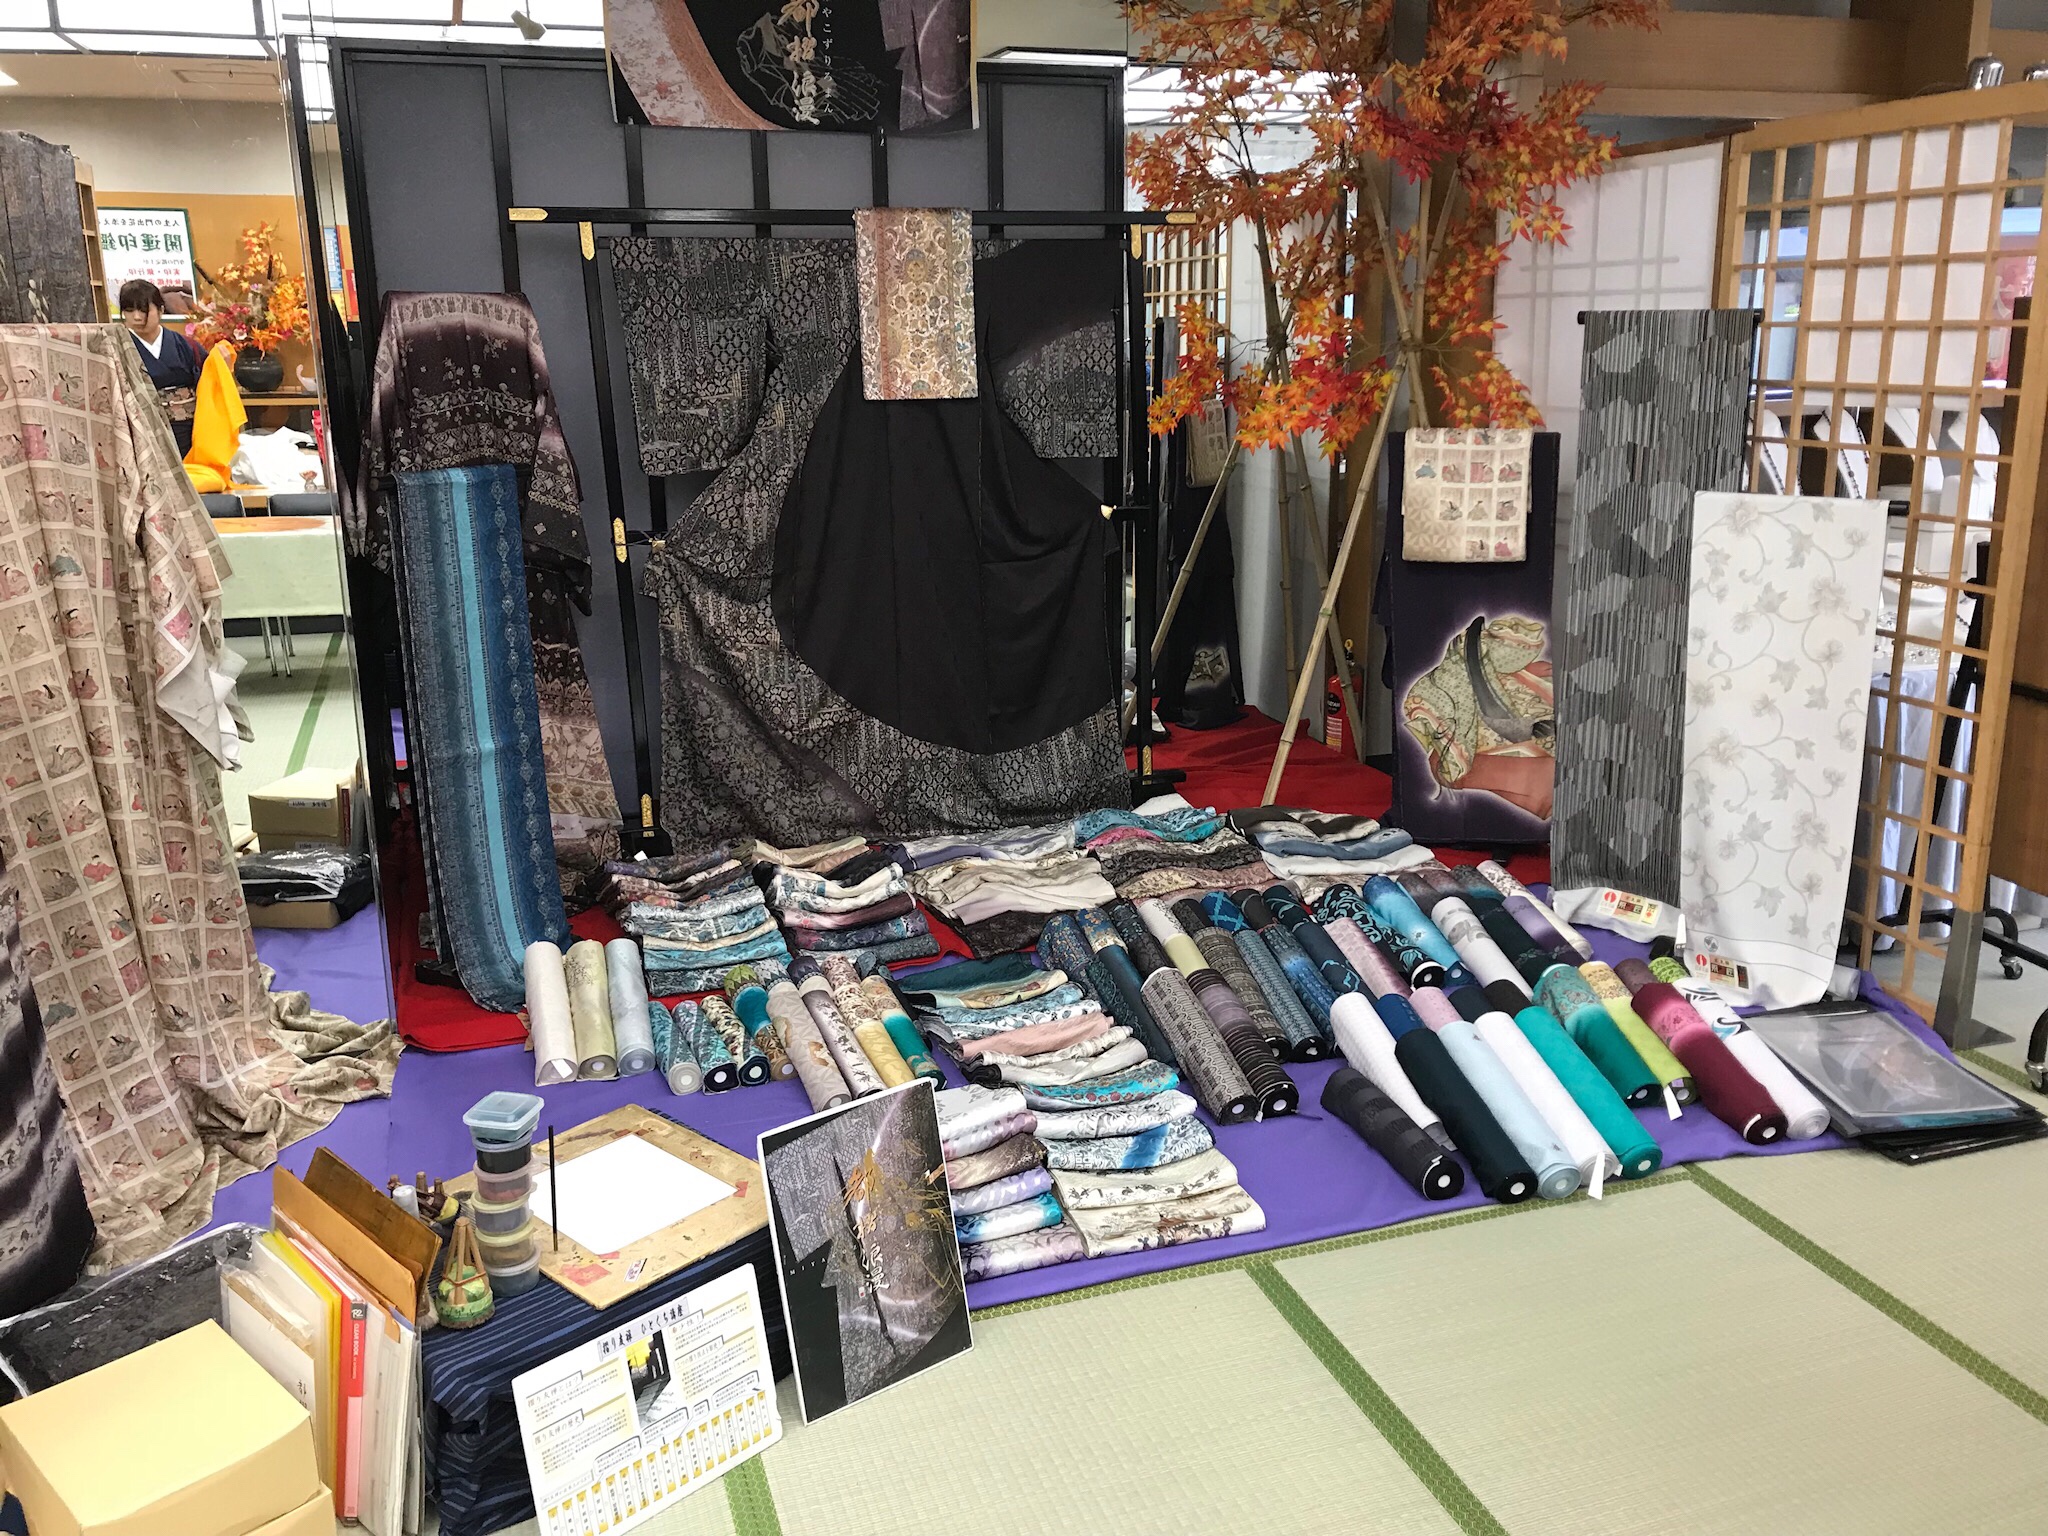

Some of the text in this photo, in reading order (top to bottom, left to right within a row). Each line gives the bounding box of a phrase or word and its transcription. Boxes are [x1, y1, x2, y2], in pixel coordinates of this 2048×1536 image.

[822, 0, 833, 113] やこずりろまん
